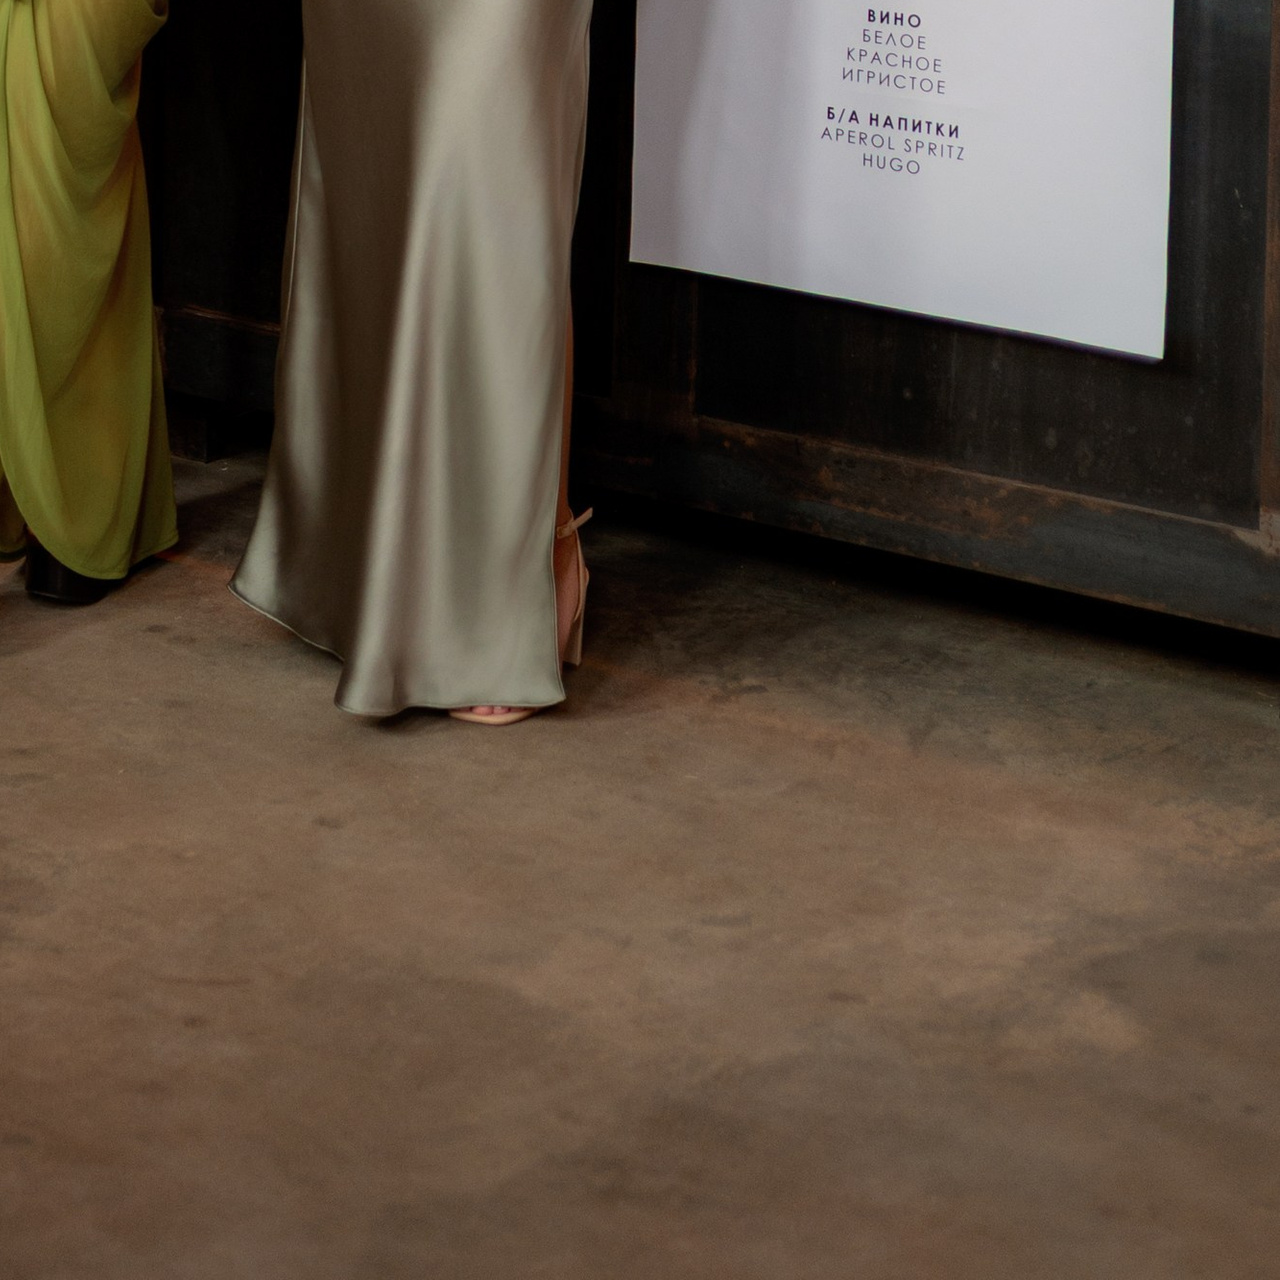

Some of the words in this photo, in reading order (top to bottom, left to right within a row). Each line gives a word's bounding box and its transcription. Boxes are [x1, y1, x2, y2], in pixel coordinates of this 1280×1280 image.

[867, 8, 922, 29] ВИНО
[862, 28, 927, 51] БЕЛОЕ
[846, 46, 942, 74] КРАСНОЕ
[842, 66, 946, 95] ИГРИСТОЕ
[826, 105, 860, 125] Б/А
[868, 112, 959, 140] НАПИТКИ
[820, 126, 896, 151] APEROL
[903, 137, 965, 161] SPRITZ
[862, 152, 921, 175] HUGO
